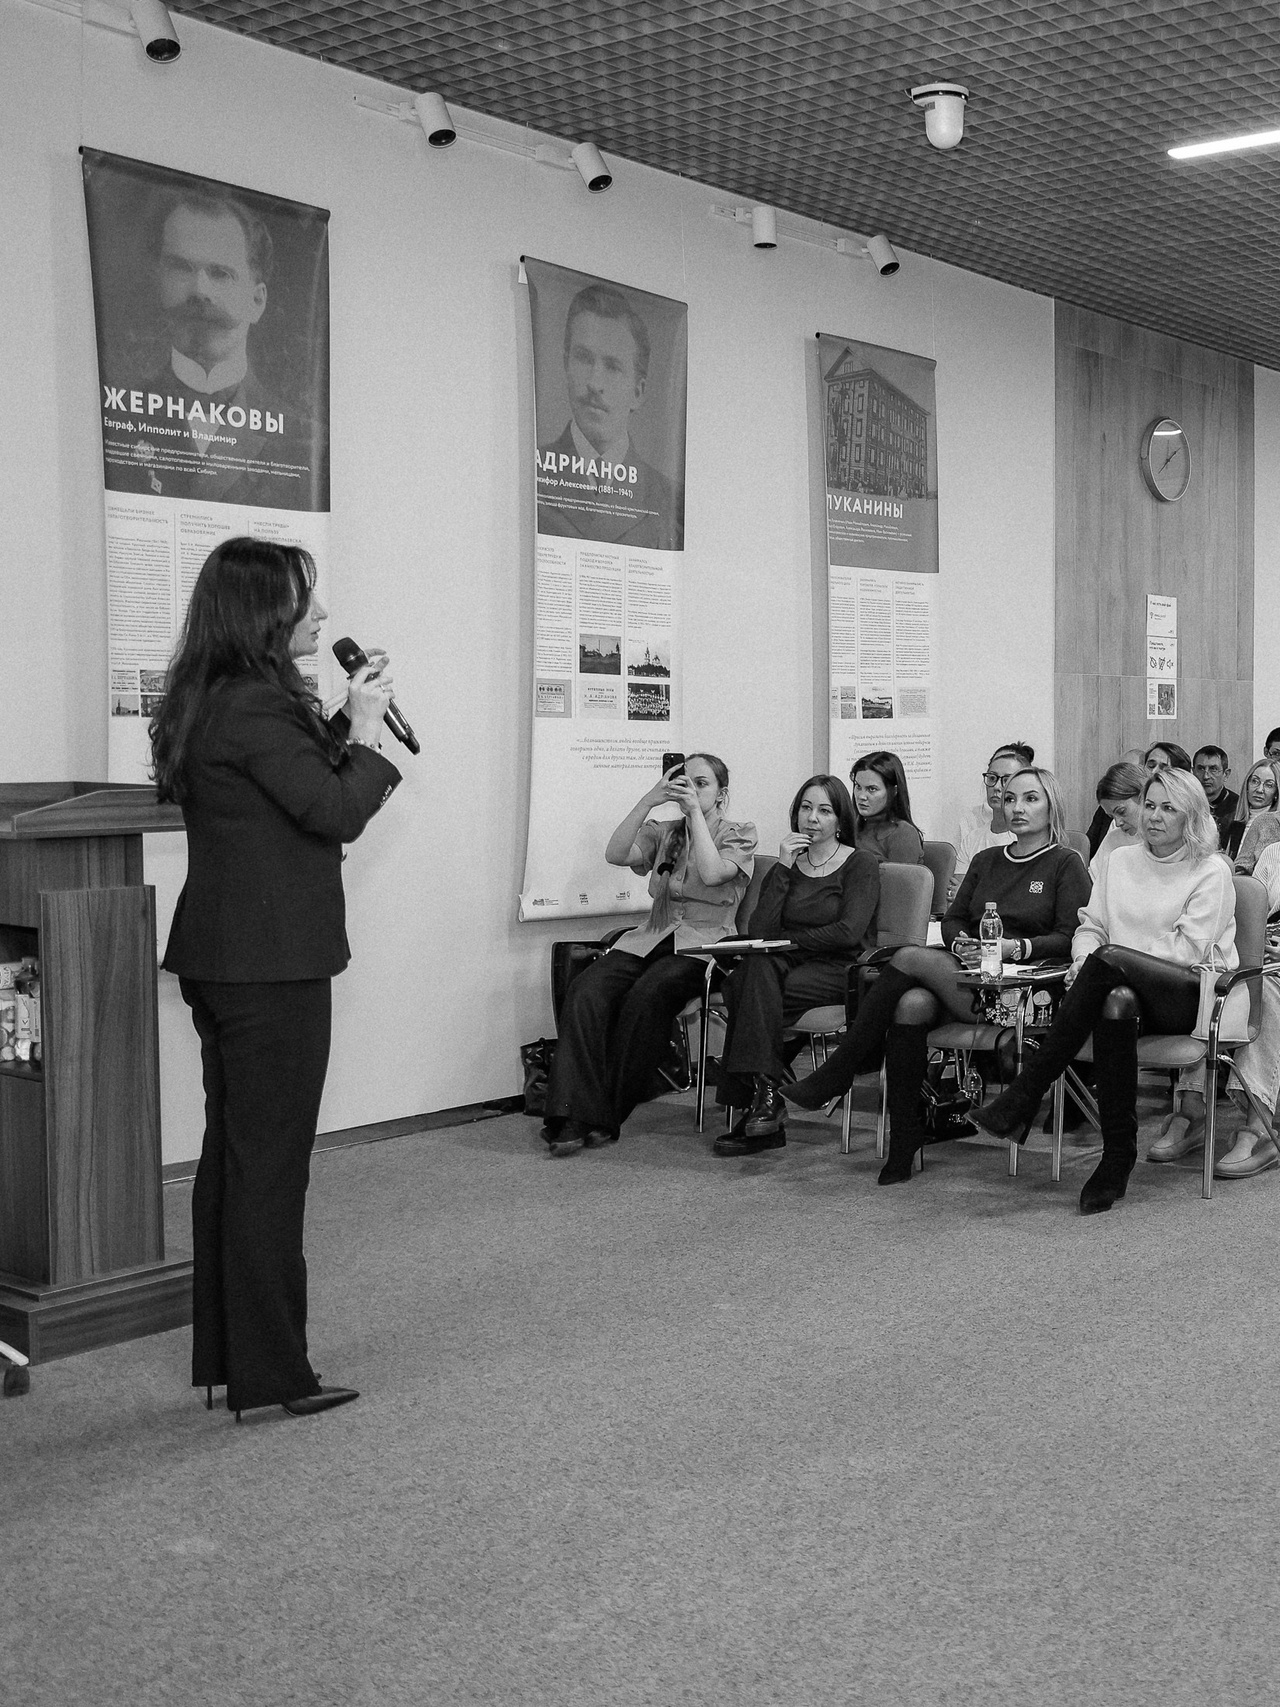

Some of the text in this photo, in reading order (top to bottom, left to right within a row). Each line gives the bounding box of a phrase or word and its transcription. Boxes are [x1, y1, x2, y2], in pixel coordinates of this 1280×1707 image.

[103, 385, 285, 434] ЖЕРНАКОВЫ
[104, 416, 237, 446] Евграф, Ипполит и Владимир
[535, 448, 638, 484] АДРИАНОВ
[559, 479, 598, 493] Алексеевич
